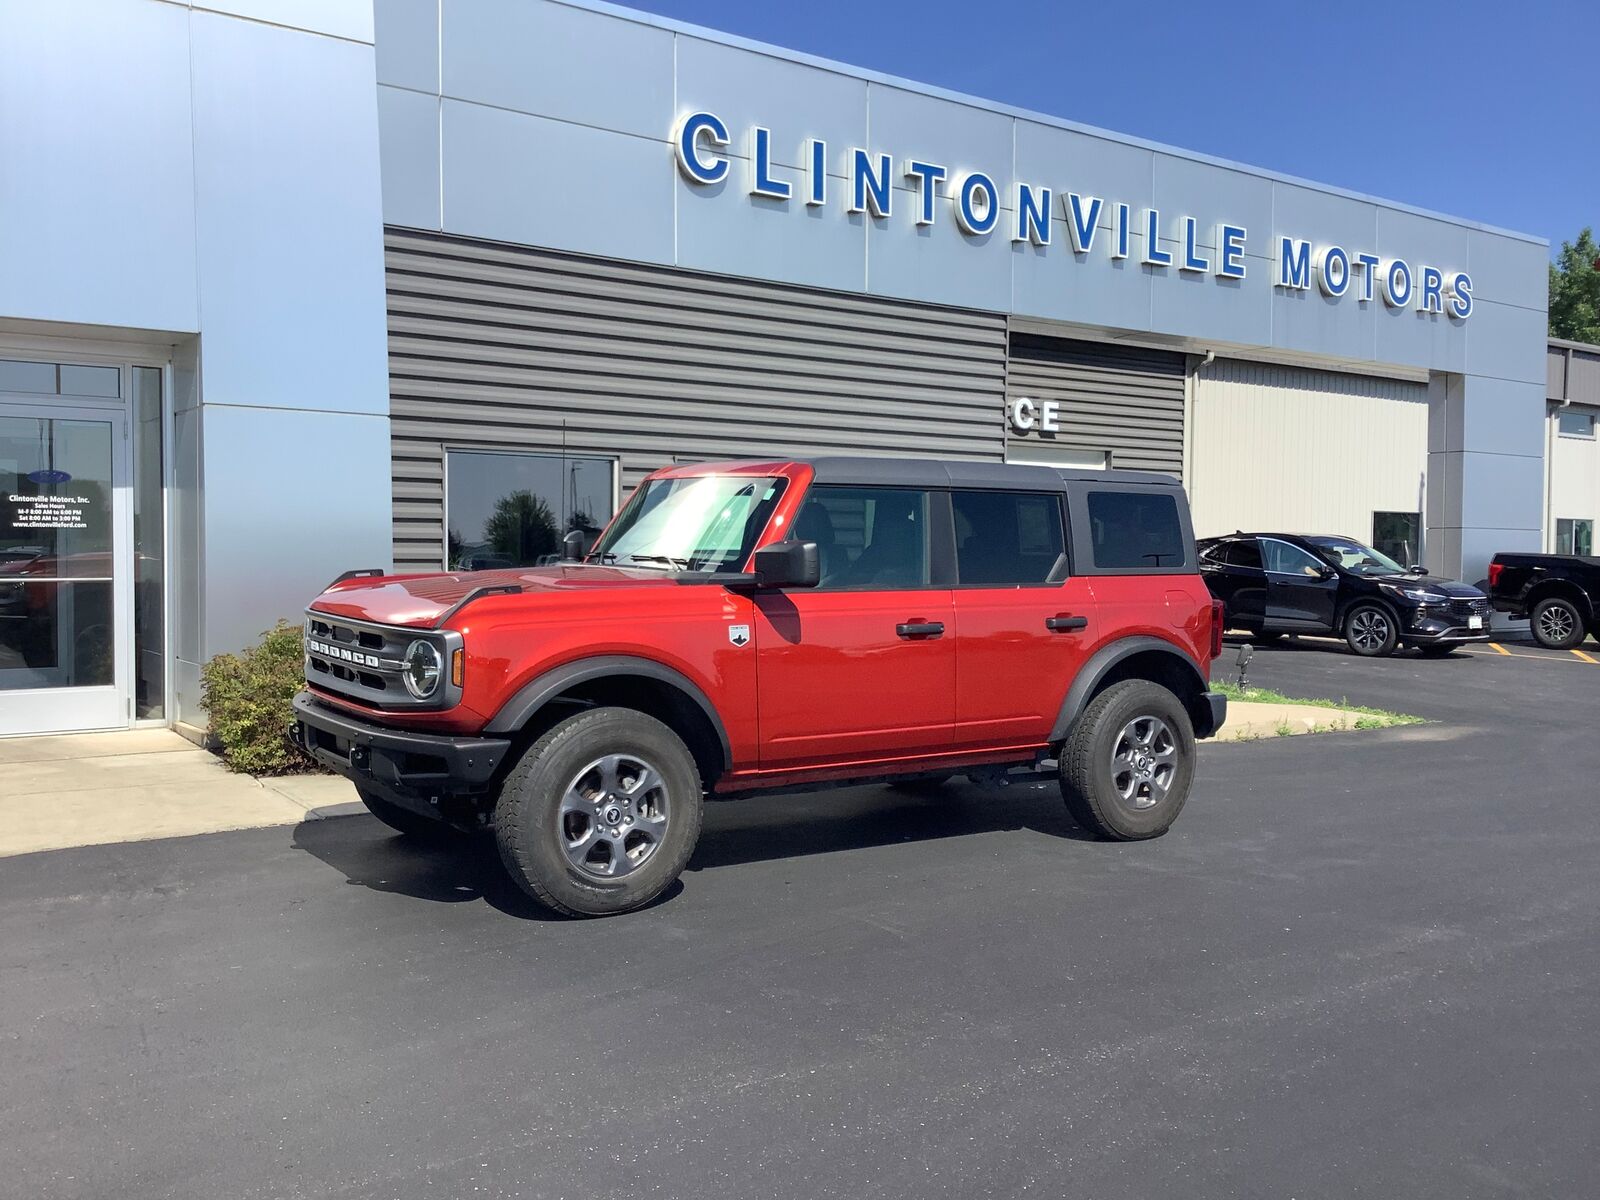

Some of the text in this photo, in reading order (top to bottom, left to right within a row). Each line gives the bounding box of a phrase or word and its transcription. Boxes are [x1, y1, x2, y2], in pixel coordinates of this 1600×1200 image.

[675, 111, 1473, 319] CLINTONVILLE MOTORS
[1012, 397, 1060, 431] CE
[9, 495, 48, 503] Clintonville
[50, 496, 76, 504] Motors,
[310, 640, 379, 667] BRONCO
